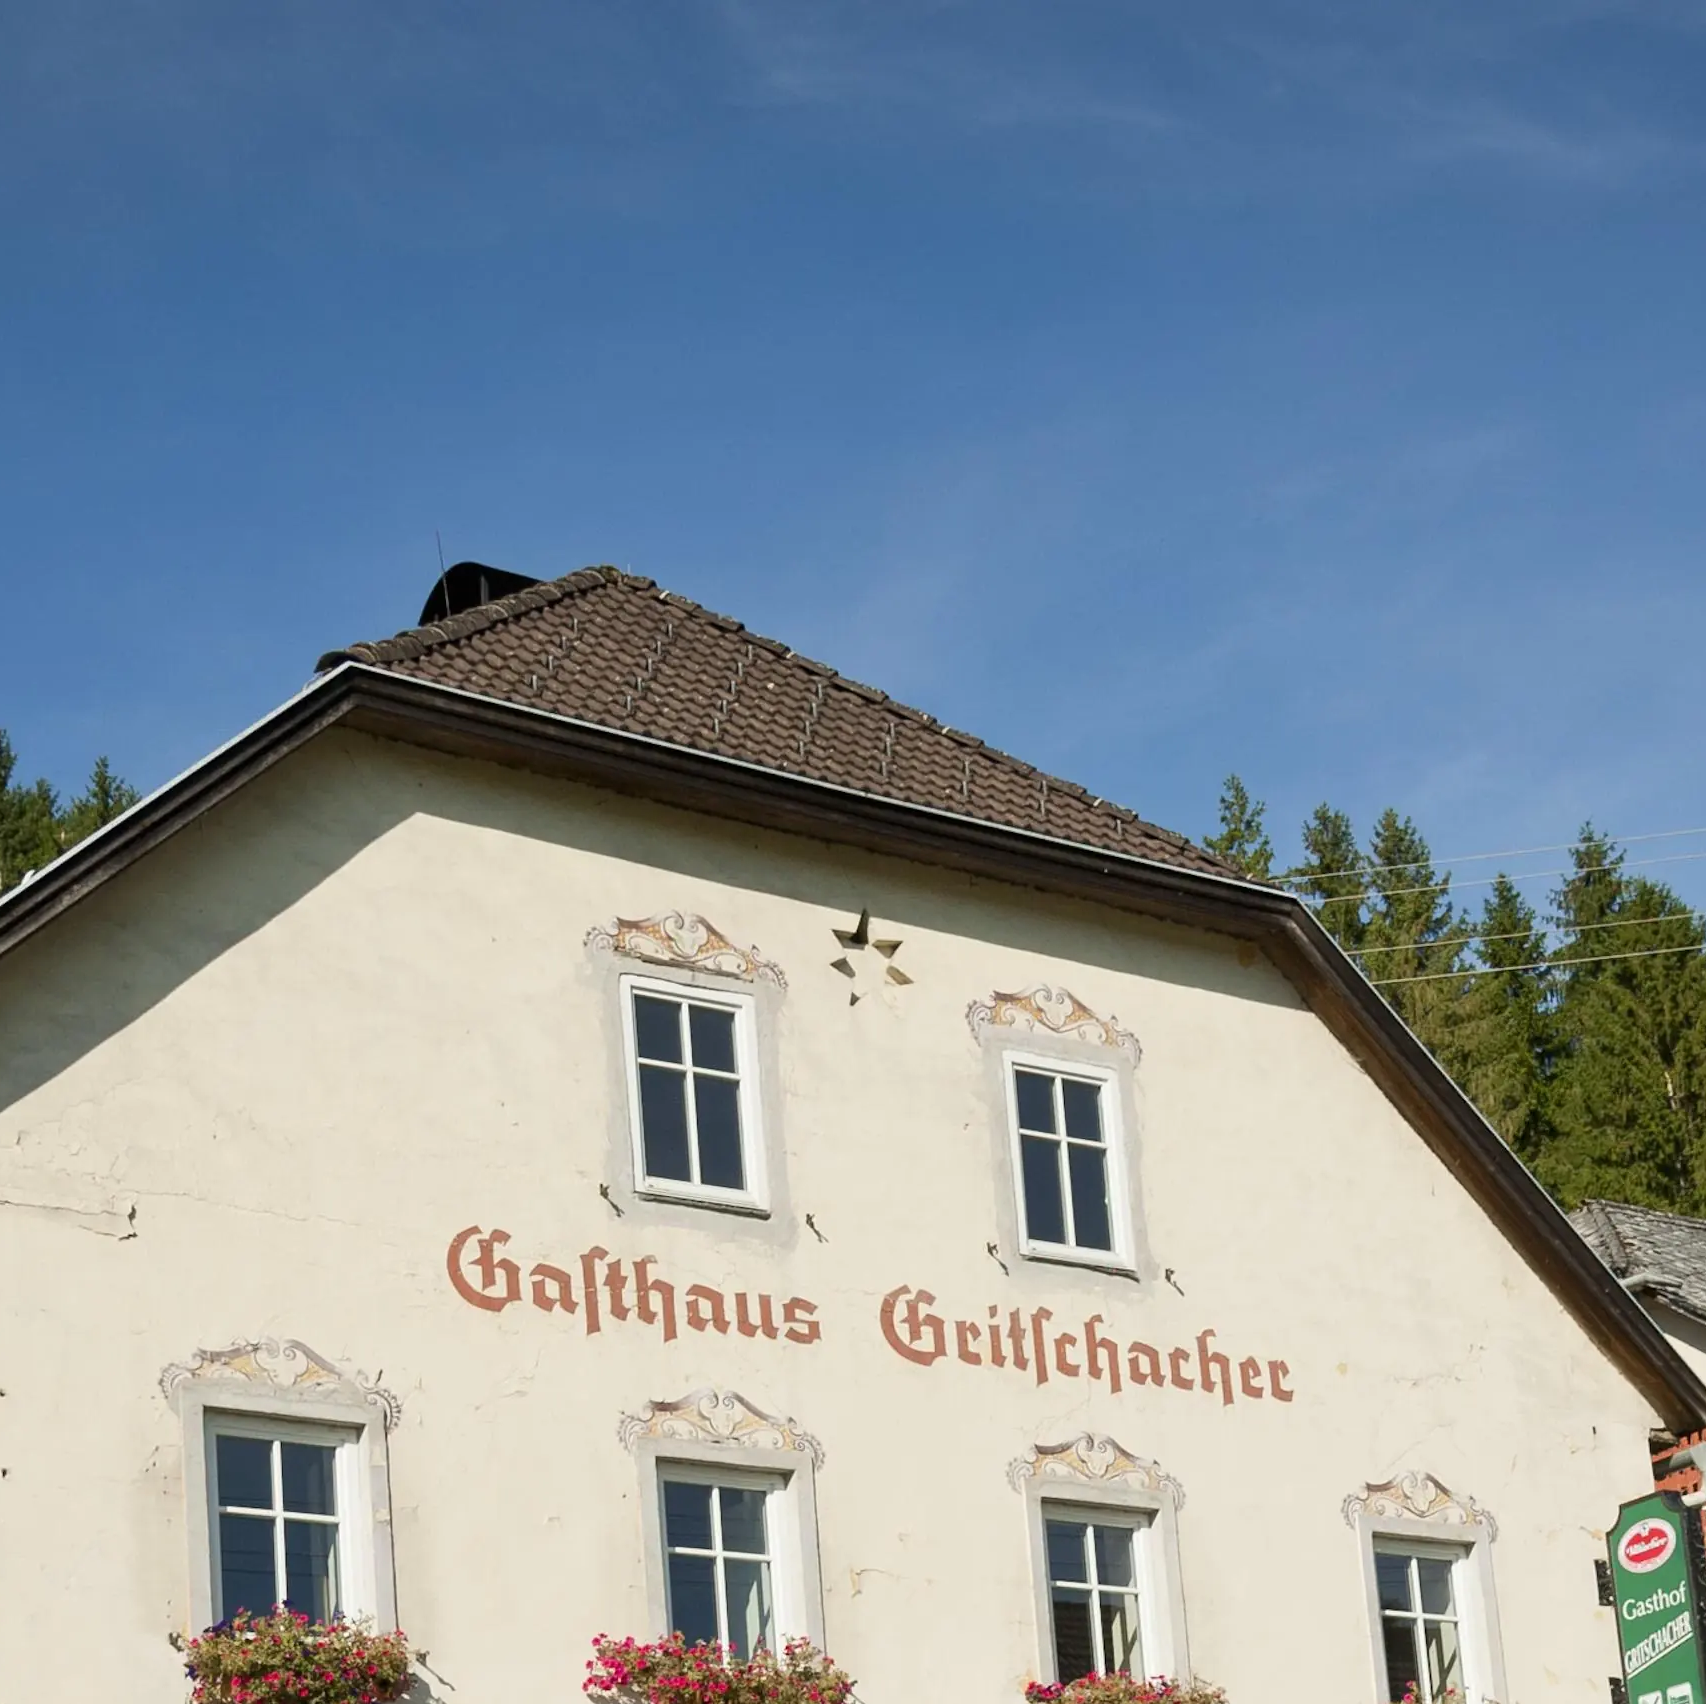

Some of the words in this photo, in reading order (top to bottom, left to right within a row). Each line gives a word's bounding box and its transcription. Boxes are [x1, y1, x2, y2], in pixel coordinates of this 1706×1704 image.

[446, 1225, 822, 1344] Gasthaus
[880, 1284, 1294, 1405] Gritschacher
[1622, 1580, 1686, 1620] Gasthof
[1624, 1611, 1693, 1674] GRITSCHACHER
